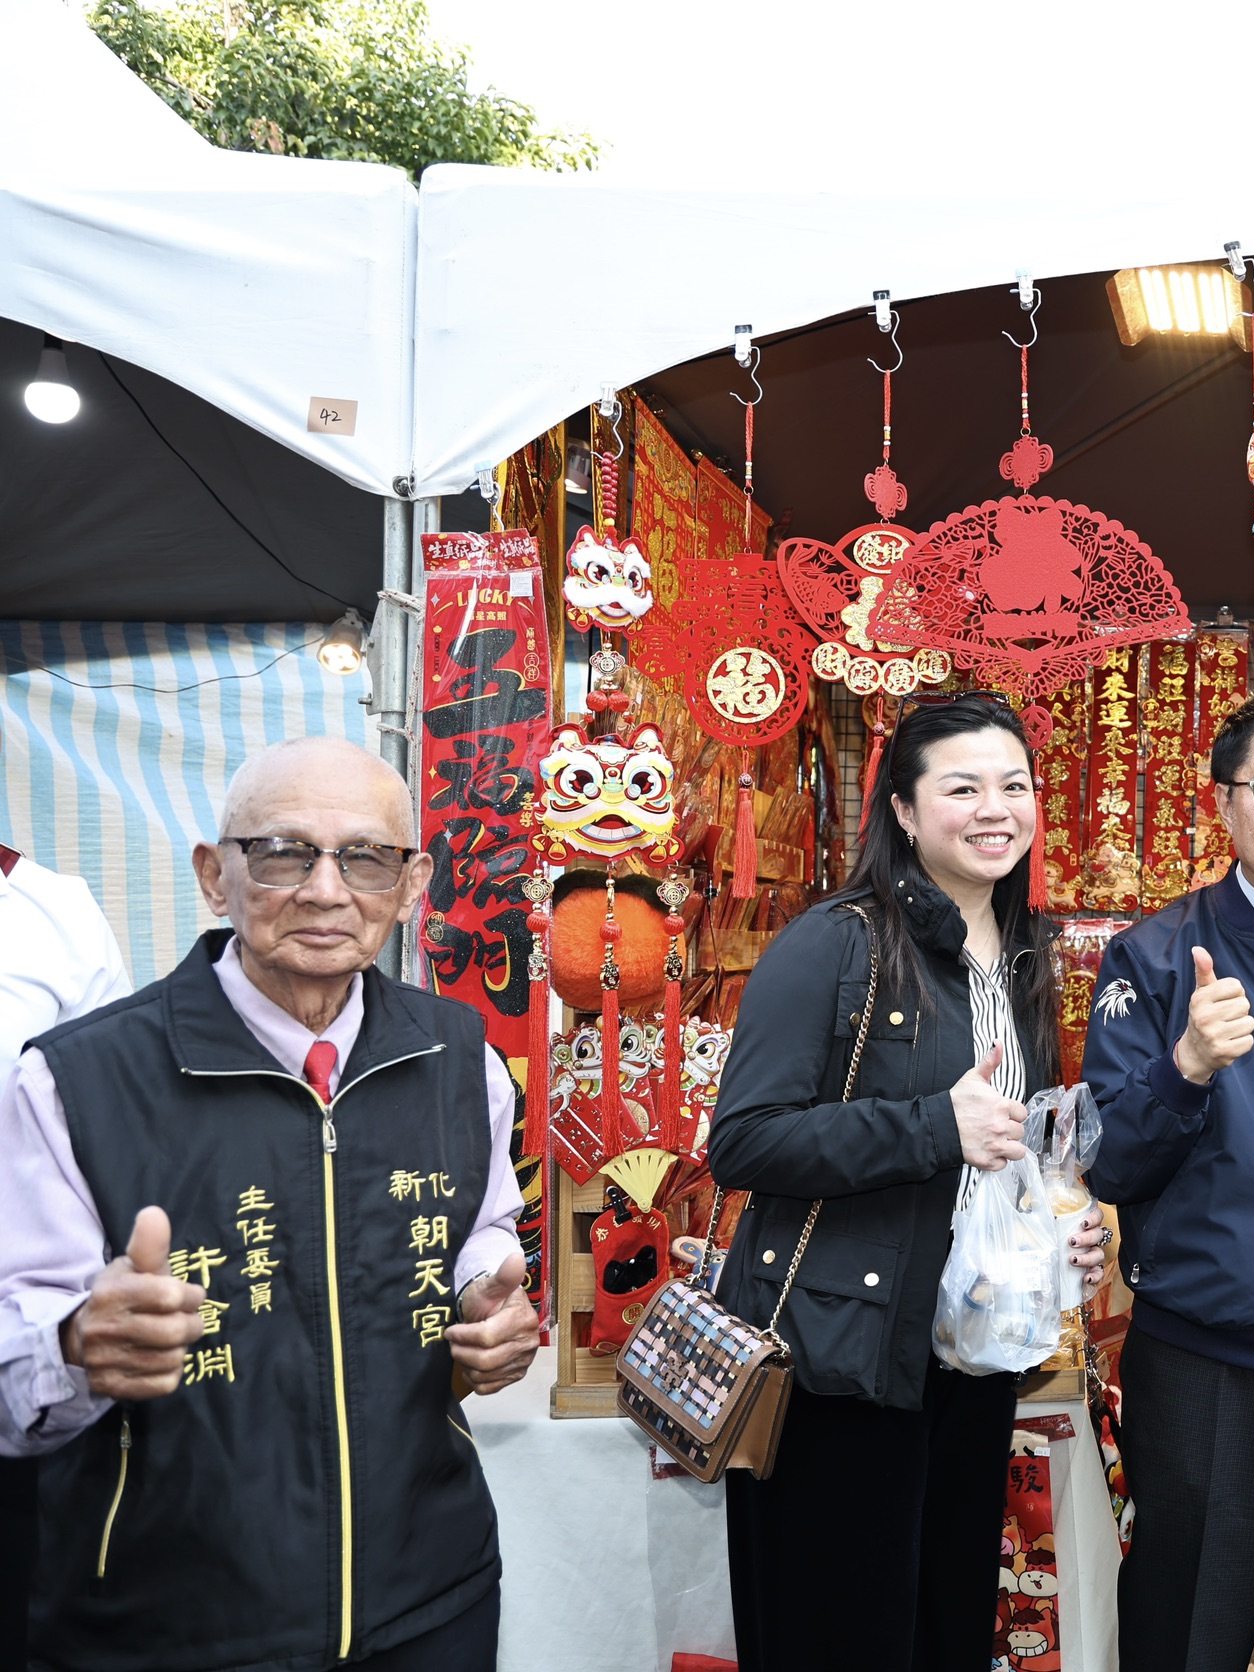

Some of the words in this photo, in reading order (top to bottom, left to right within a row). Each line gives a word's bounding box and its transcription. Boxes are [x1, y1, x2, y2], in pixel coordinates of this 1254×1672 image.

[319, 408, 342, 425] 42
[708, 651, 778, 717] 福
[388, 1170, 456, 1202] 新化
[236, 1185, 280, 1315] 主任委員
[408, 1215, 451, 1348] 朝天宮
[1009, 1465, 1044, 1494] 駿
